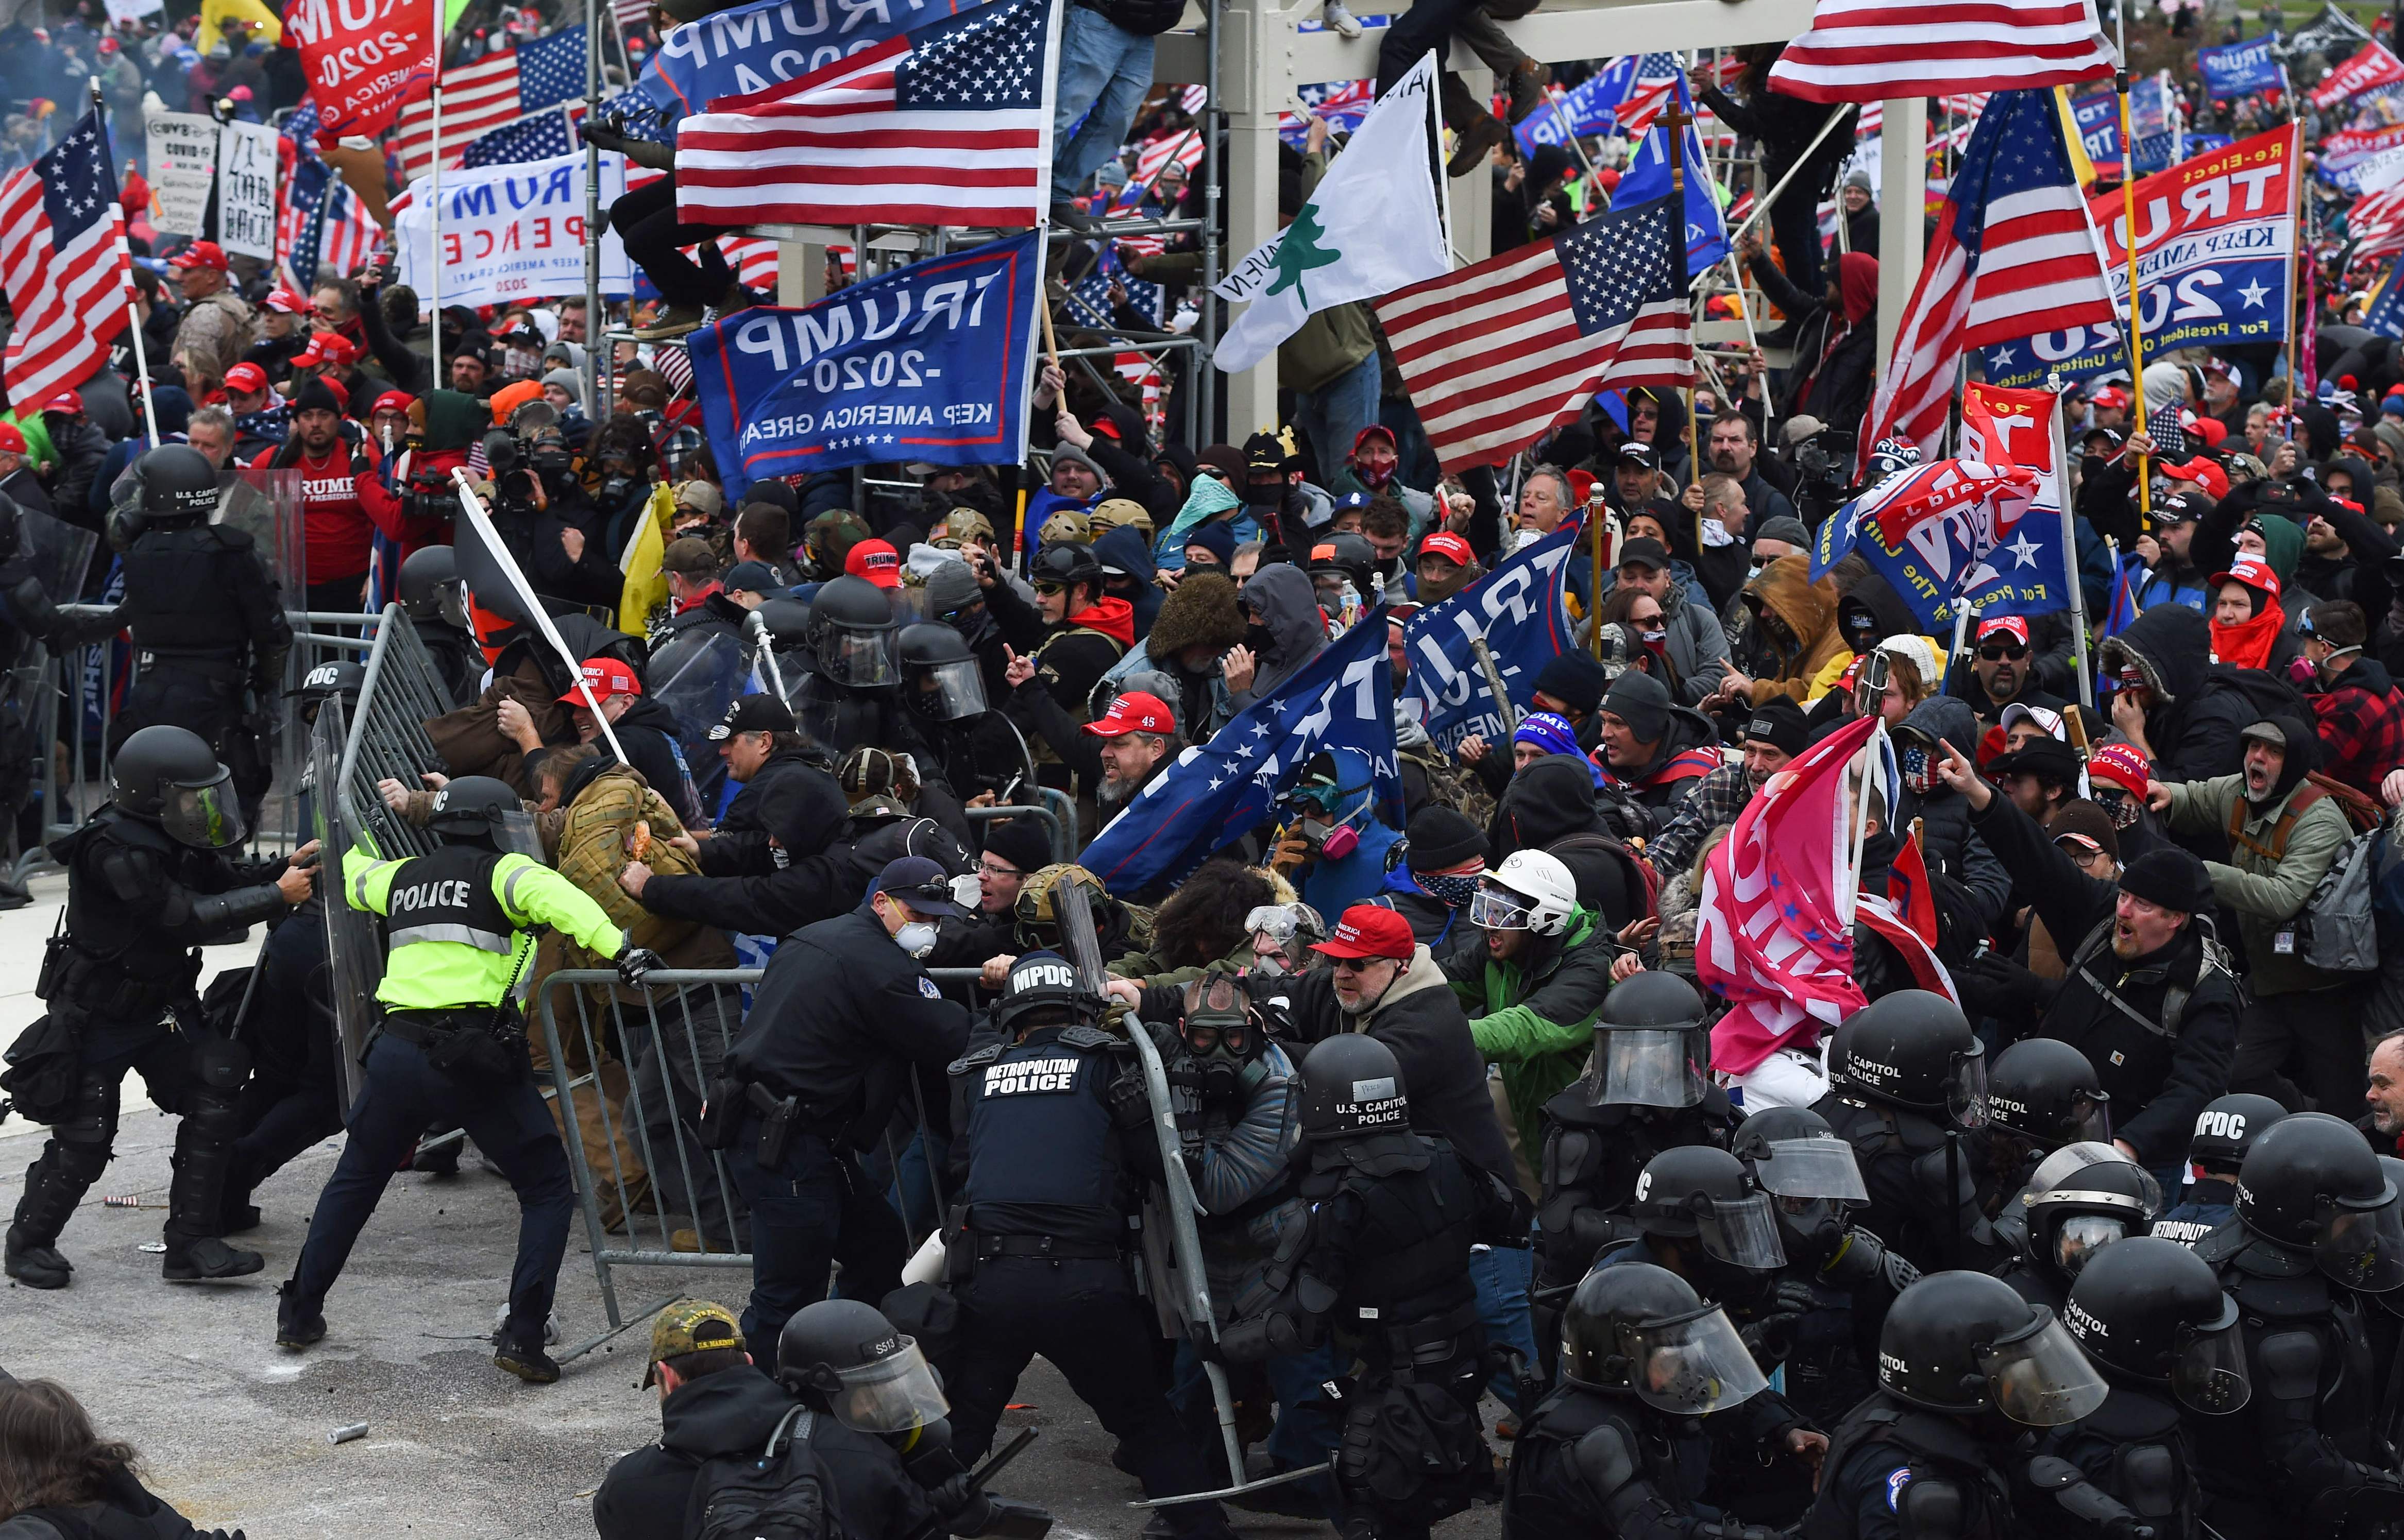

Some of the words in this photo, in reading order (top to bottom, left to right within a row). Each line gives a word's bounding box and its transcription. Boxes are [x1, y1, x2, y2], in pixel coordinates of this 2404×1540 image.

[302, 477, 354, 495] RUMP
[190, 496, 215, 506] POLICE
[865, 556, 896, 565] TRUMP
[581, 668, 604, 677] MERICA
[1142, 716, 1155, 727] 45
[2092, 756, 2132, 775] 2020
[392, 879, 471, 916] POLICE
[1340, 933, 1356, 943] AGAIN
[1013, 964, 1073, 995] MPDC
[985, 1057, 1080, 1082] METROPOLITAN
[1848, 1063, 1881, 1086] POLICE
[1854, 1055, 1902, 1079] CAPITOL
[984, 1073, 1073, 1097] POLICE
[1335, 1103, 1361, 1114] U.S.
[1363, 1096, 1407, 1114] CAPITOL
[1988, 1093, 2028, 1114] APITOL
[1358, 1109, 1400, 1125] POLICE
[2069, 1298, 2109, 1338] CAPITOL
[875, 1338, 895, 1355] S513
